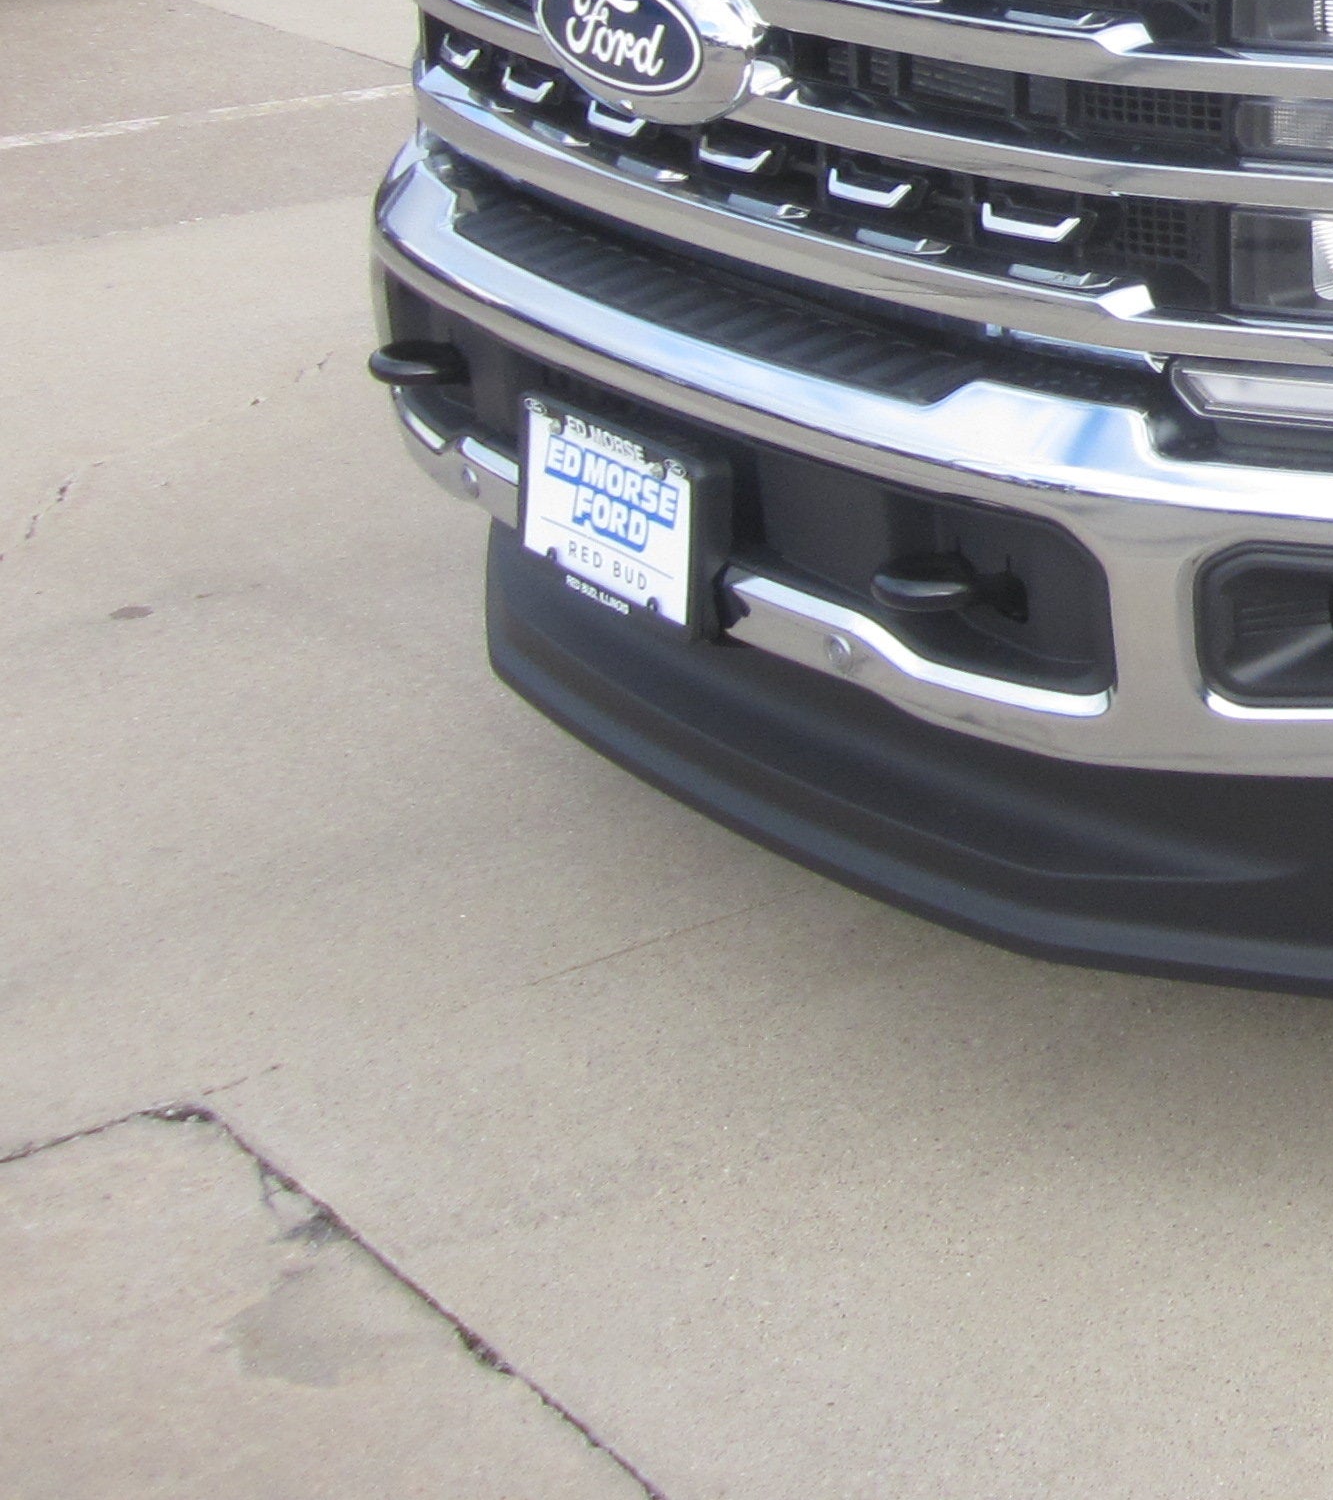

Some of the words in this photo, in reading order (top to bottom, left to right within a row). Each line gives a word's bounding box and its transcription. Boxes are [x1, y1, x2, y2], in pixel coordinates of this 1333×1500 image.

[565, 414, 588, 438] ED
[547, 437, 583, 479] ED
[582, 449, 679, 525] MORSE
[573, 487, 648, 550] FORD
[568, 540, 602, 569] RED
[612, 560, 648, 591] BUD
